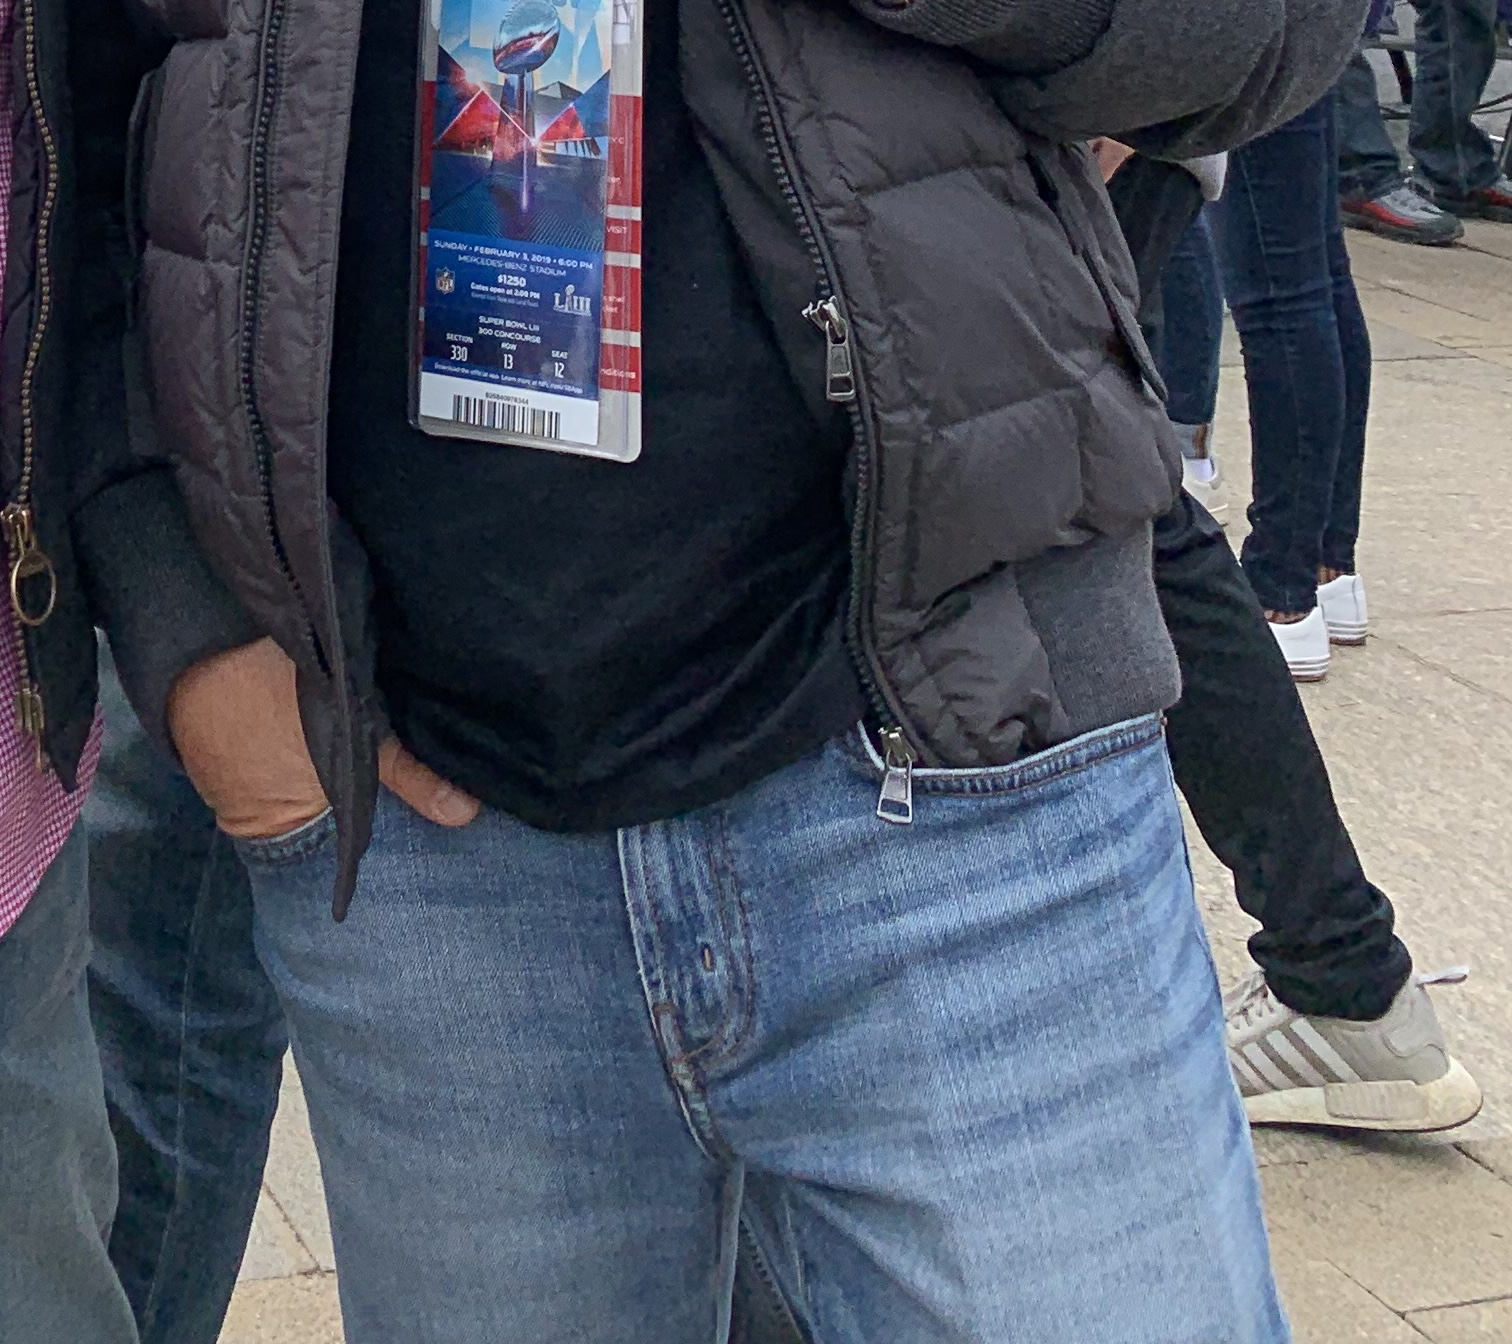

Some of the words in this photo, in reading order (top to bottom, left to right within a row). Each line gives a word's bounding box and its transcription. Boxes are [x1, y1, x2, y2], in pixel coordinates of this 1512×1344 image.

[434, 239, 468, 252] SUNDAY
[473, 245, 521, 260] FEBRUARY
[522, 252, 530, 262] 3,
[531, 254, 552, 264] 2019
[557, 258, 578, 268] 6:00
[579, 261, 593, 270] PM
[529, 265, 566, 277] STADIUM
[470, 282, 489, 292] Gates
[489, 286, 506, 295] open
[506, 288, 514, 296] at
[497, 274, 527, 288] $1250
[478, 315, 505, 327] SUPER
[505, 319, 528, 330] BOWL
[478, 326, 494, 337] 300
[494, 329, 542, 344] CONCOURSE
[445, 332, 474, 344] SECTION
[500, 341, 517, 351] ROW
[551, 350, 569, 360] SEAT
[450, 344, 468, 362] 330
[503, 353, 514, 370] 13
[554, 362, 565, 379] 12
